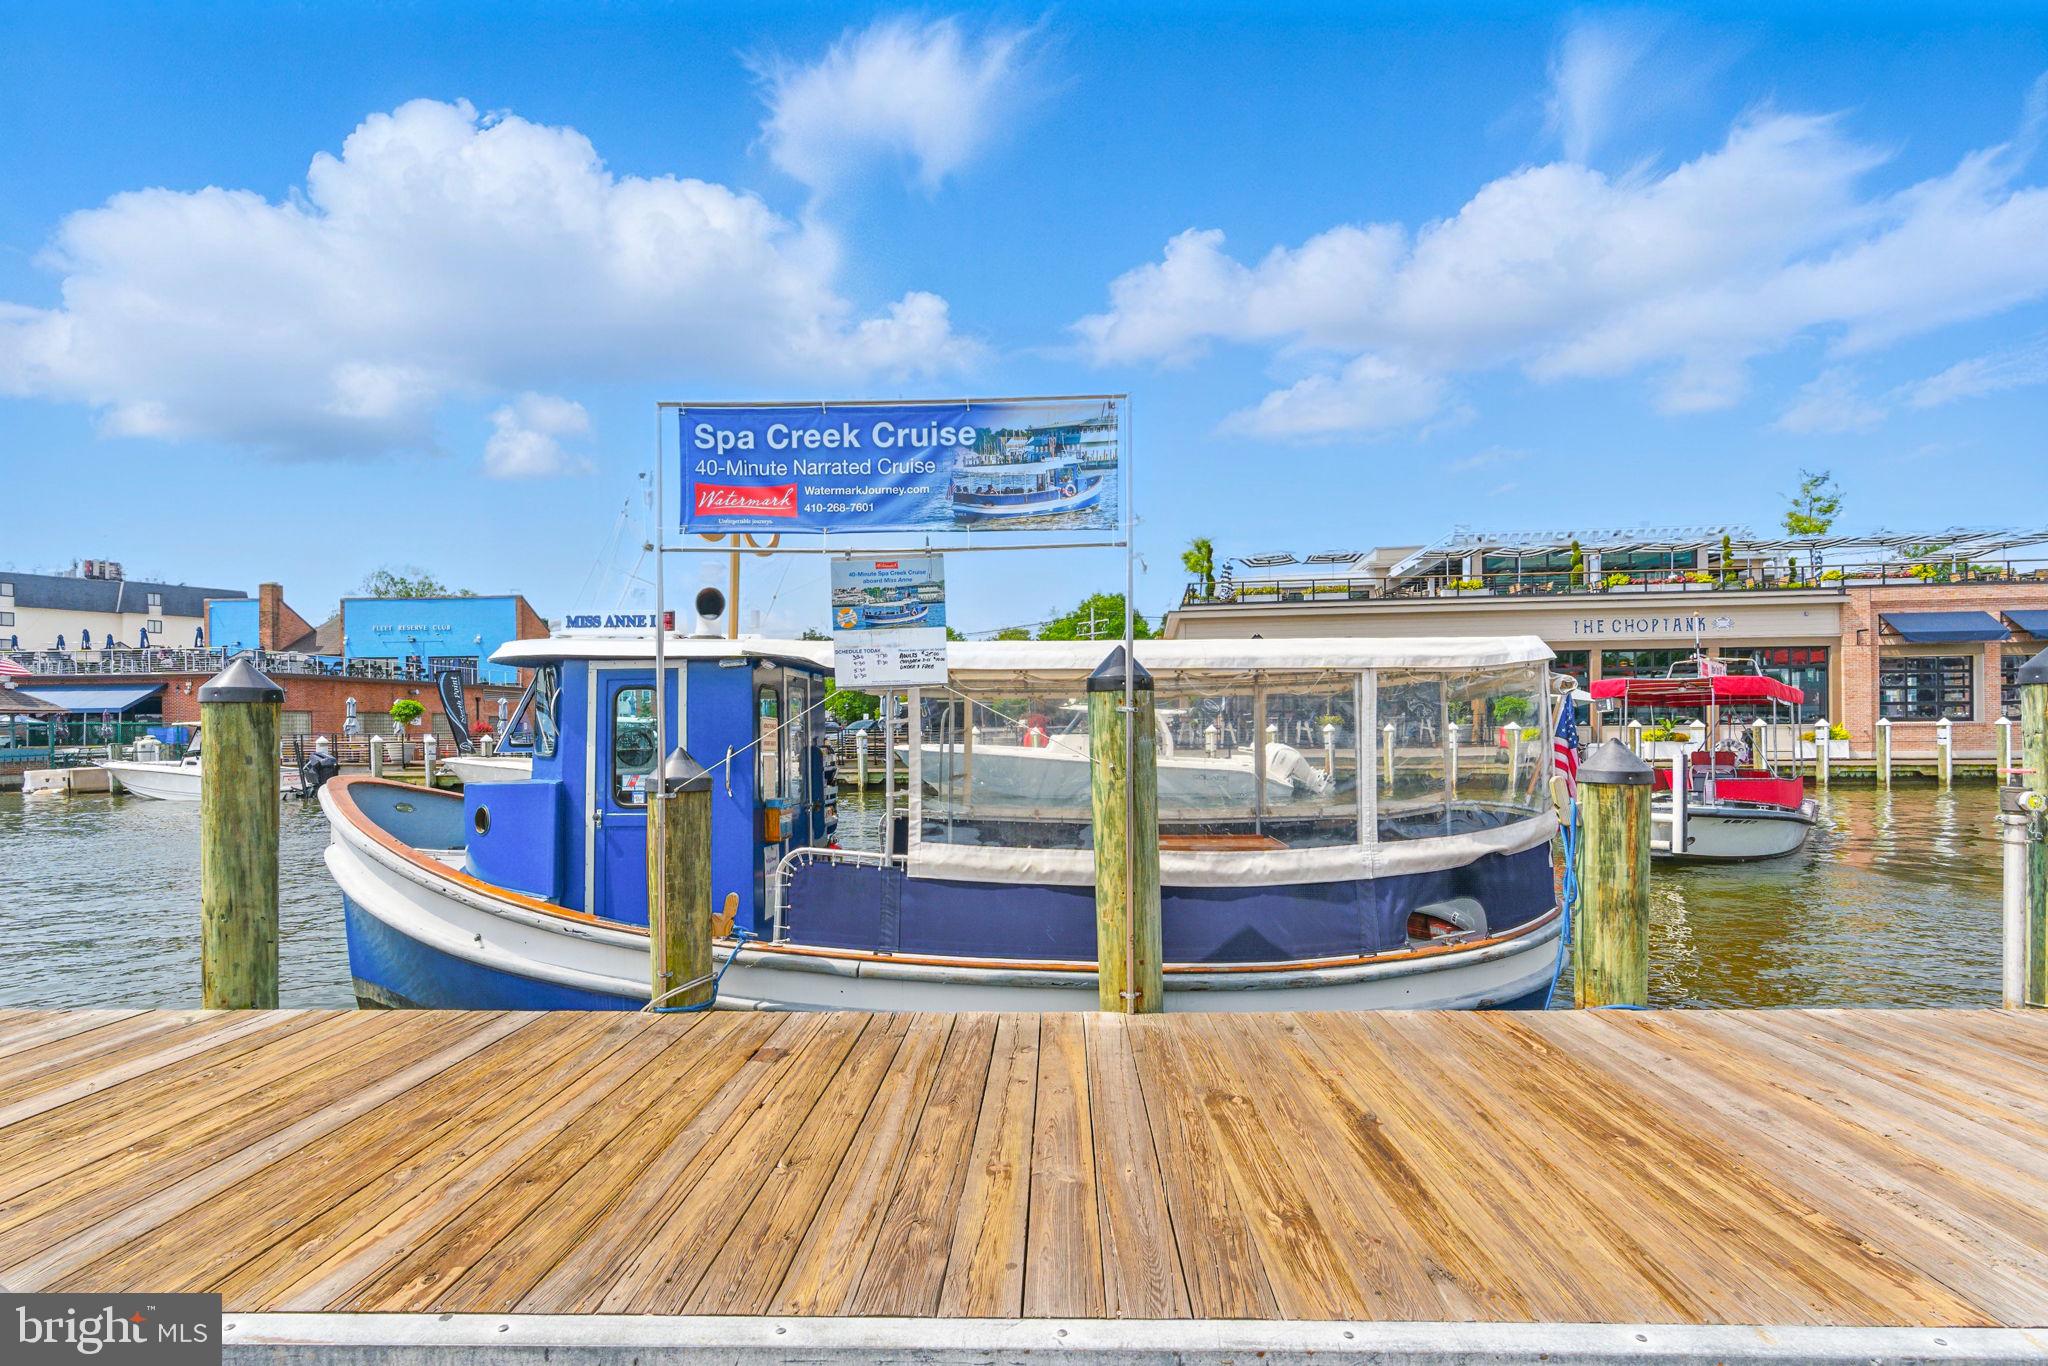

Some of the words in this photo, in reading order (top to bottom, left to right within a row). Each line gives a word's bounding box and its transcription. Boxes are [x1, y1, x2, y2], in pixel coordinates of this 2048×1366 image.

[694, 423, 754, 454] Spa
[766, 422, 862, 449] Creek
[872, 421, 976, 448] Cruise
[694, 459, 788, 476] 40-Minute
[794, 458, 871, 476] Narrated
[877, 458, 936, 474] Cruise
[698, 488, 792, 508] Watermark
[804, 485, 930, 496] WatermarkJourney.com
[804, 502, 874, 512] 410-268-7601
[566, 614, 600, 628] MISS
[604, 614, 648, 628] ANNE
[1574, 619, 1604, 634] THE
[1612, 616, 1706, 634] CHOPTANK
[450, 676, 460, 698] Point
